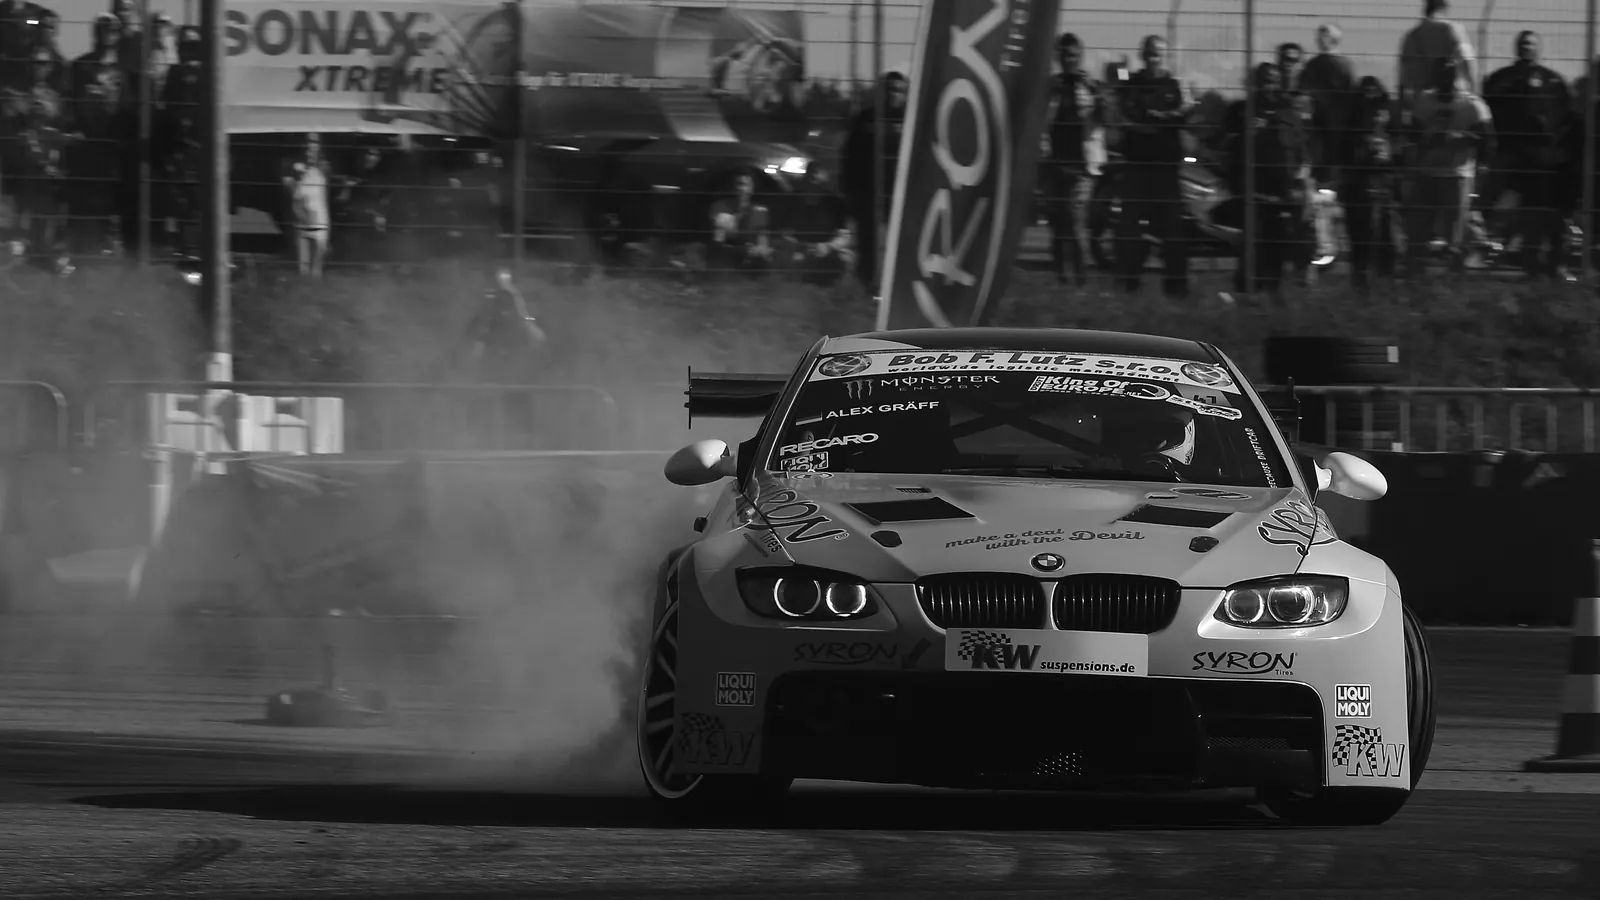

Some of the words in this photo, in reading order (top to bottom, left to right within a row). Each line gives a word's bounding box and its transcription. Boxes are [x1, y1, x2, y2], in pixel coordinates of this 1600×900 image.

[226, 9, 423, 56] SONAX
[293, 65, 449, 94] XTREME
[888, 353, 960, 367] Bob
[968, 352, 995, 364] F.
[1007, 352, 1088, 367] Lutz
[1093, 359, 1181, 376] s.r.o.
[888, 365, 979, 373] worldwide
[989, 364, 1059, 372] logistic
[1068, 367, 1181, 382] management
[880, 375, 1001, 388] MONSTER
[899, 384, 984, 392] ENERGY
[1044, 376, 1098, 387] King
[1103, 379, 1130, 389] Of
[825, 405, 874, 420] ALEX
[878, 400, 940, 414] GRÄFF
[779, 432, 880, 456] RECARO
[945, 535, 1001, 548] make
[1003, 531, 1018, 539] a
[1021, 528, 1065, 537] deal
[985, 538, 1030, 550] with
[1033, 535, 1065, 544] the
[1069, 530, 1145, 541] Devil
[793, 641, 900, 665] SYRON
[970, 644, 1042, 670] KW
[1040, 660, 1136, 674] suspensions.de
[1192, 651, 1296, 675] SYRON
[718, 673, 754, 689] LIQUI
[1274, 668, 1294, 676] Tires
[717, 689, 754, 705] MOLY
[1337, 686, 1370, 701] LIQUI
[1337, 702, 1371, 716] MOLY
[1346, 742, 1406, 777] KW
